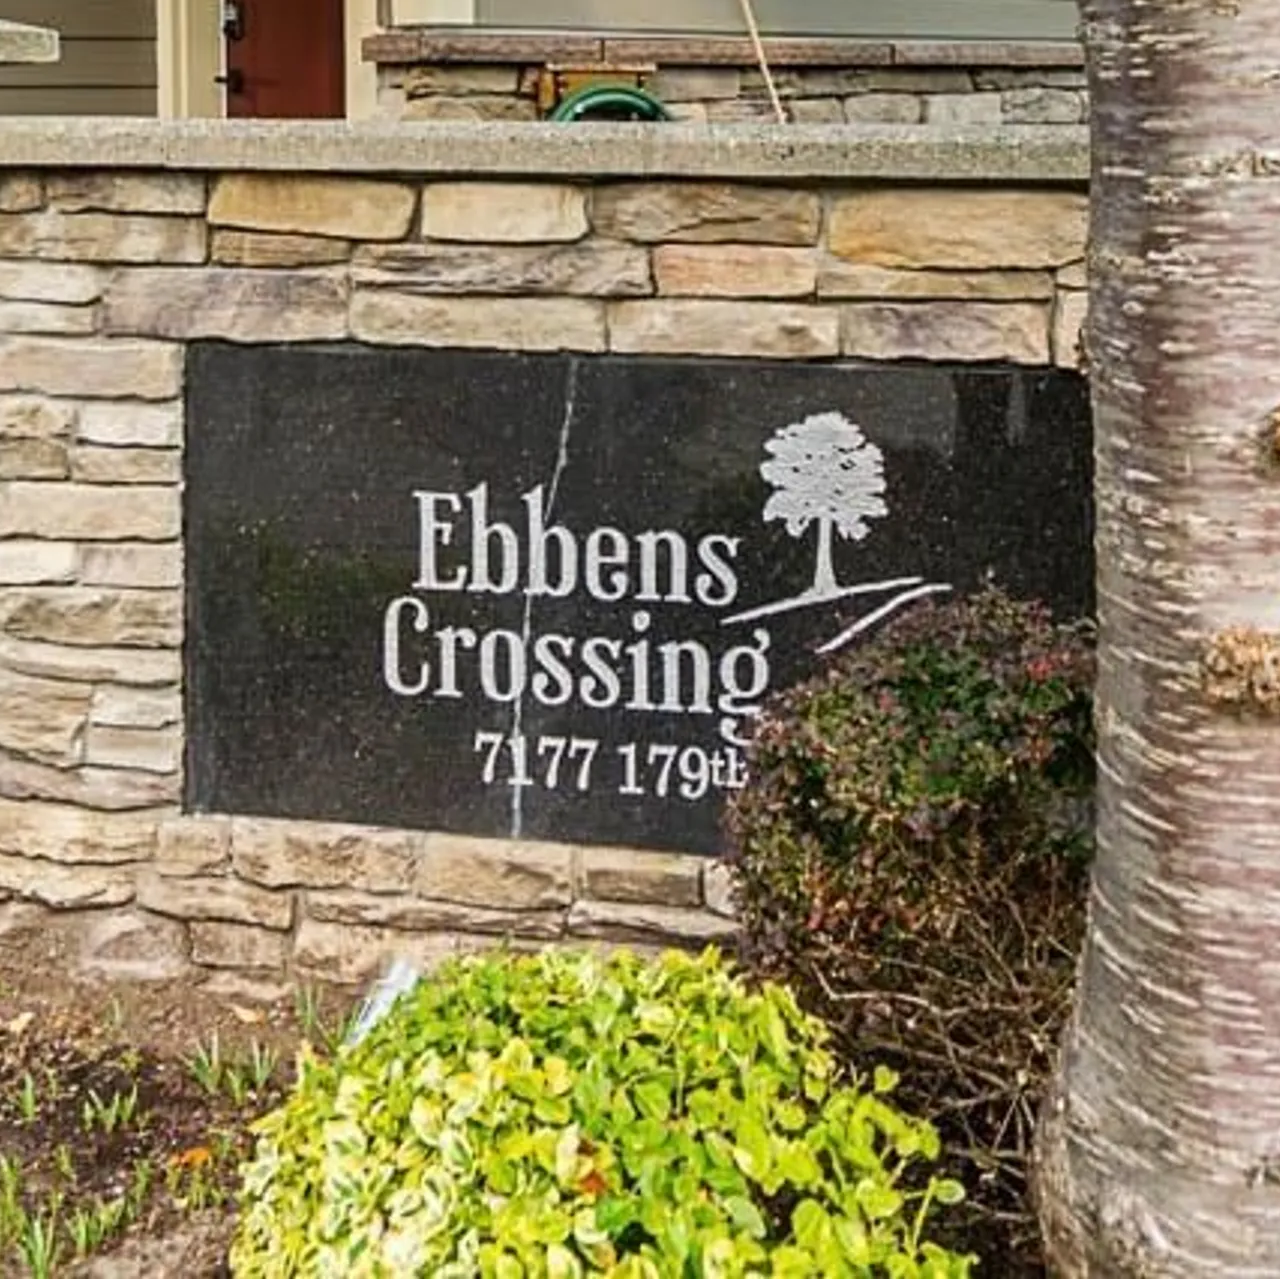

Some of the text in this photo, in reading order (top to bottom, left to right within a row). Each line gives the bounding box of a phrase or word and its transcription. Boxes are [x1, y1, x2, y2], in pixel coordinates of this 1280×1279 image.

[412, 482, 742, 606] Ebbens
[383, 596, 771, 746] Crossing
[473, 731, 599, 791] 7177
